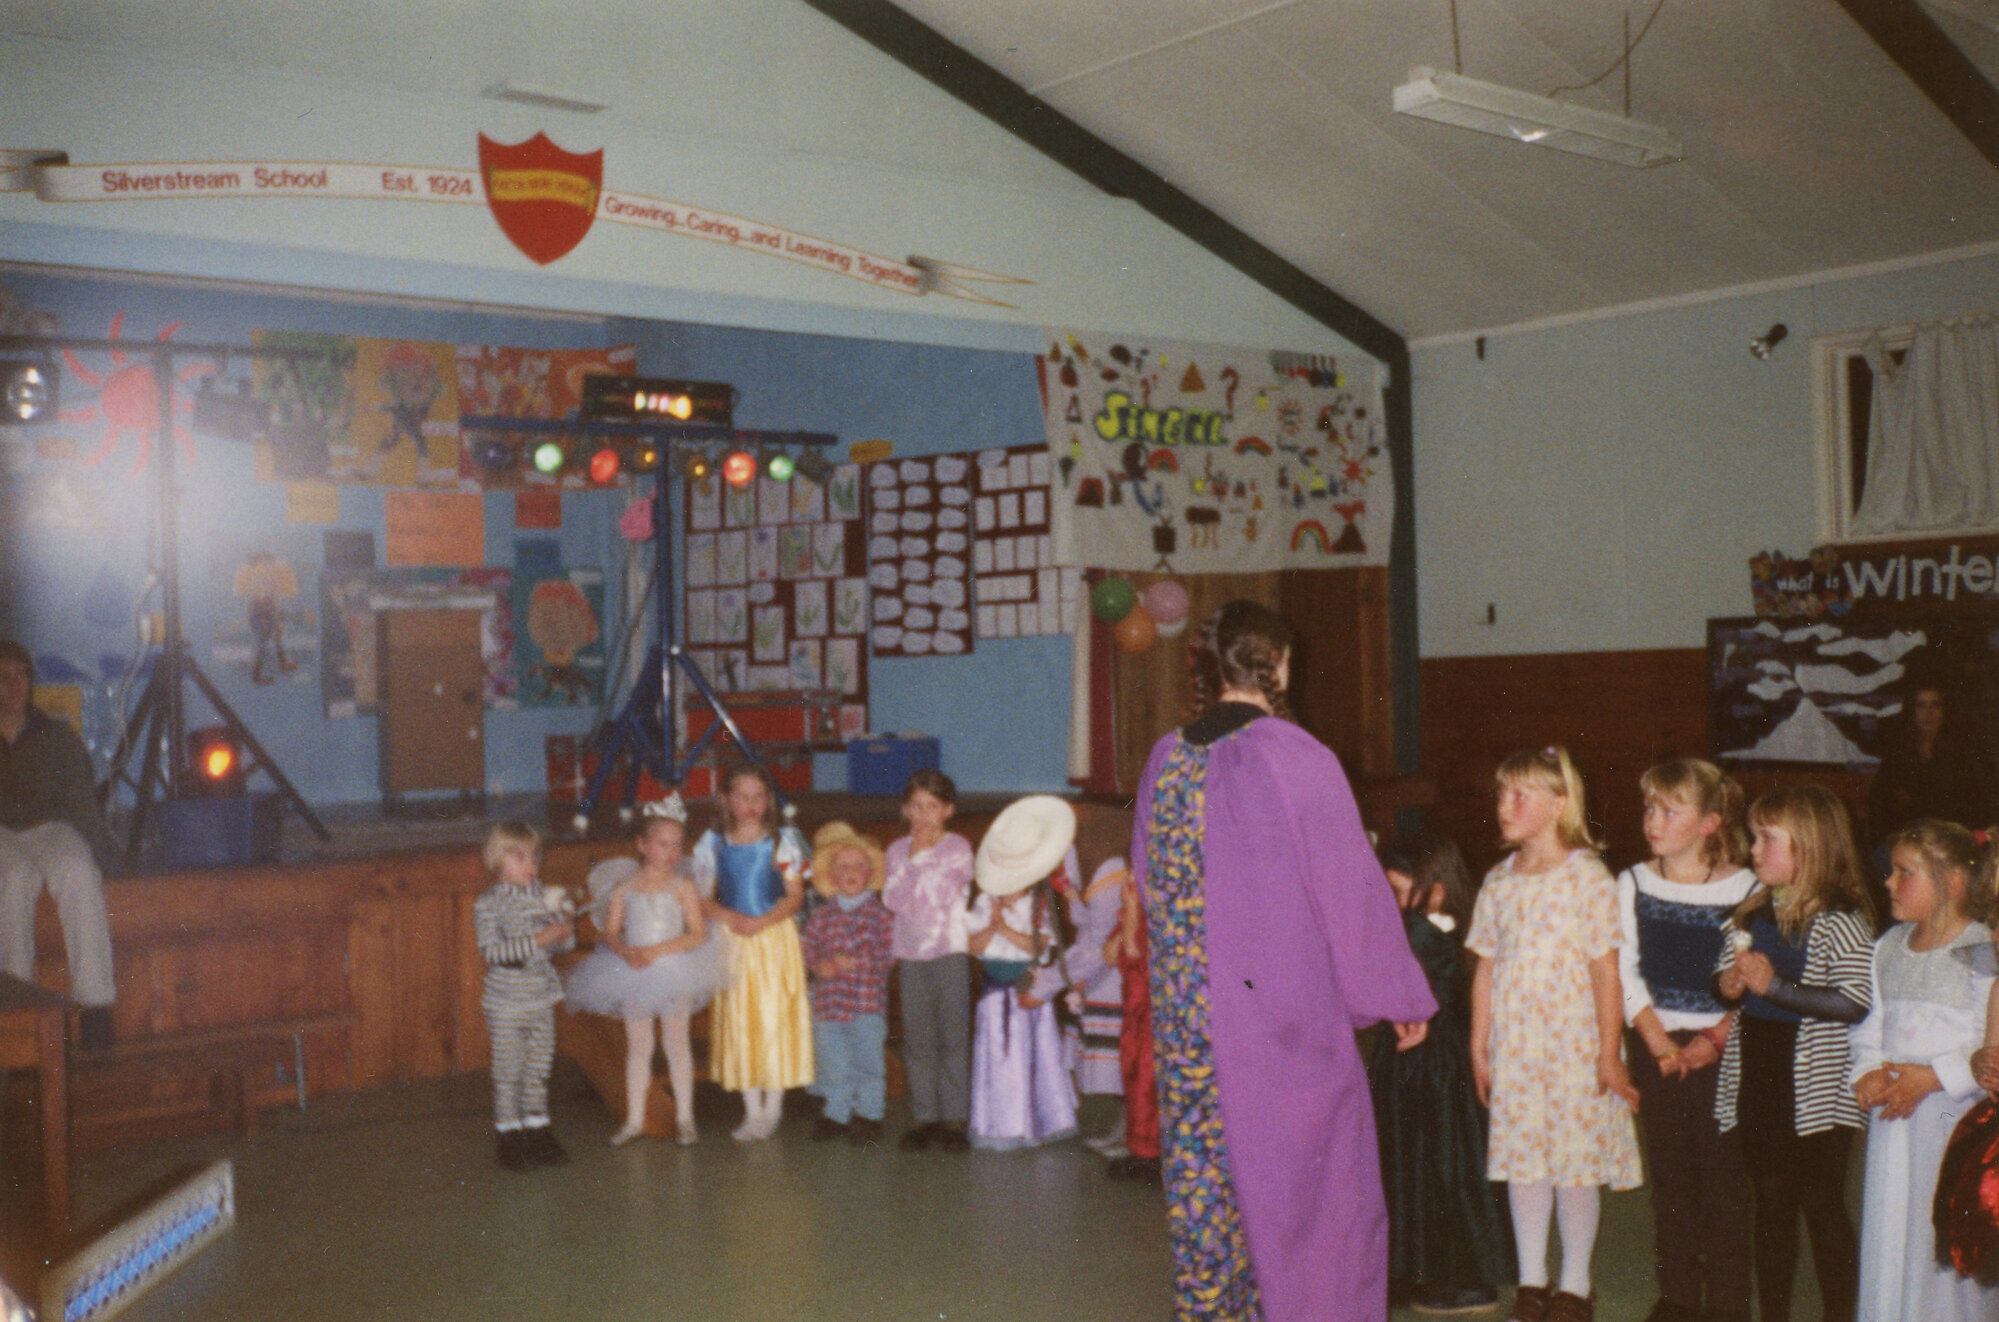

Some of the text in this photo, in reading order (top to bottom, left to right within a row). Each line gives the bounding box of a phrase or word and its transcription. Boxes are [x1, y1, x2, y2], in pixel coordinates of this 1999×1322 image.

[101, 166, 329, 193] Silverstream School
[381, 171, 419, 192] Est.
[427, 173, 473, 196] 1924
[751, 230, 782, 249] and
[784, 235, 852, 273] Learning
[858, 255, 920, 287] Together
[1842, 545, 1999, 602] winte
